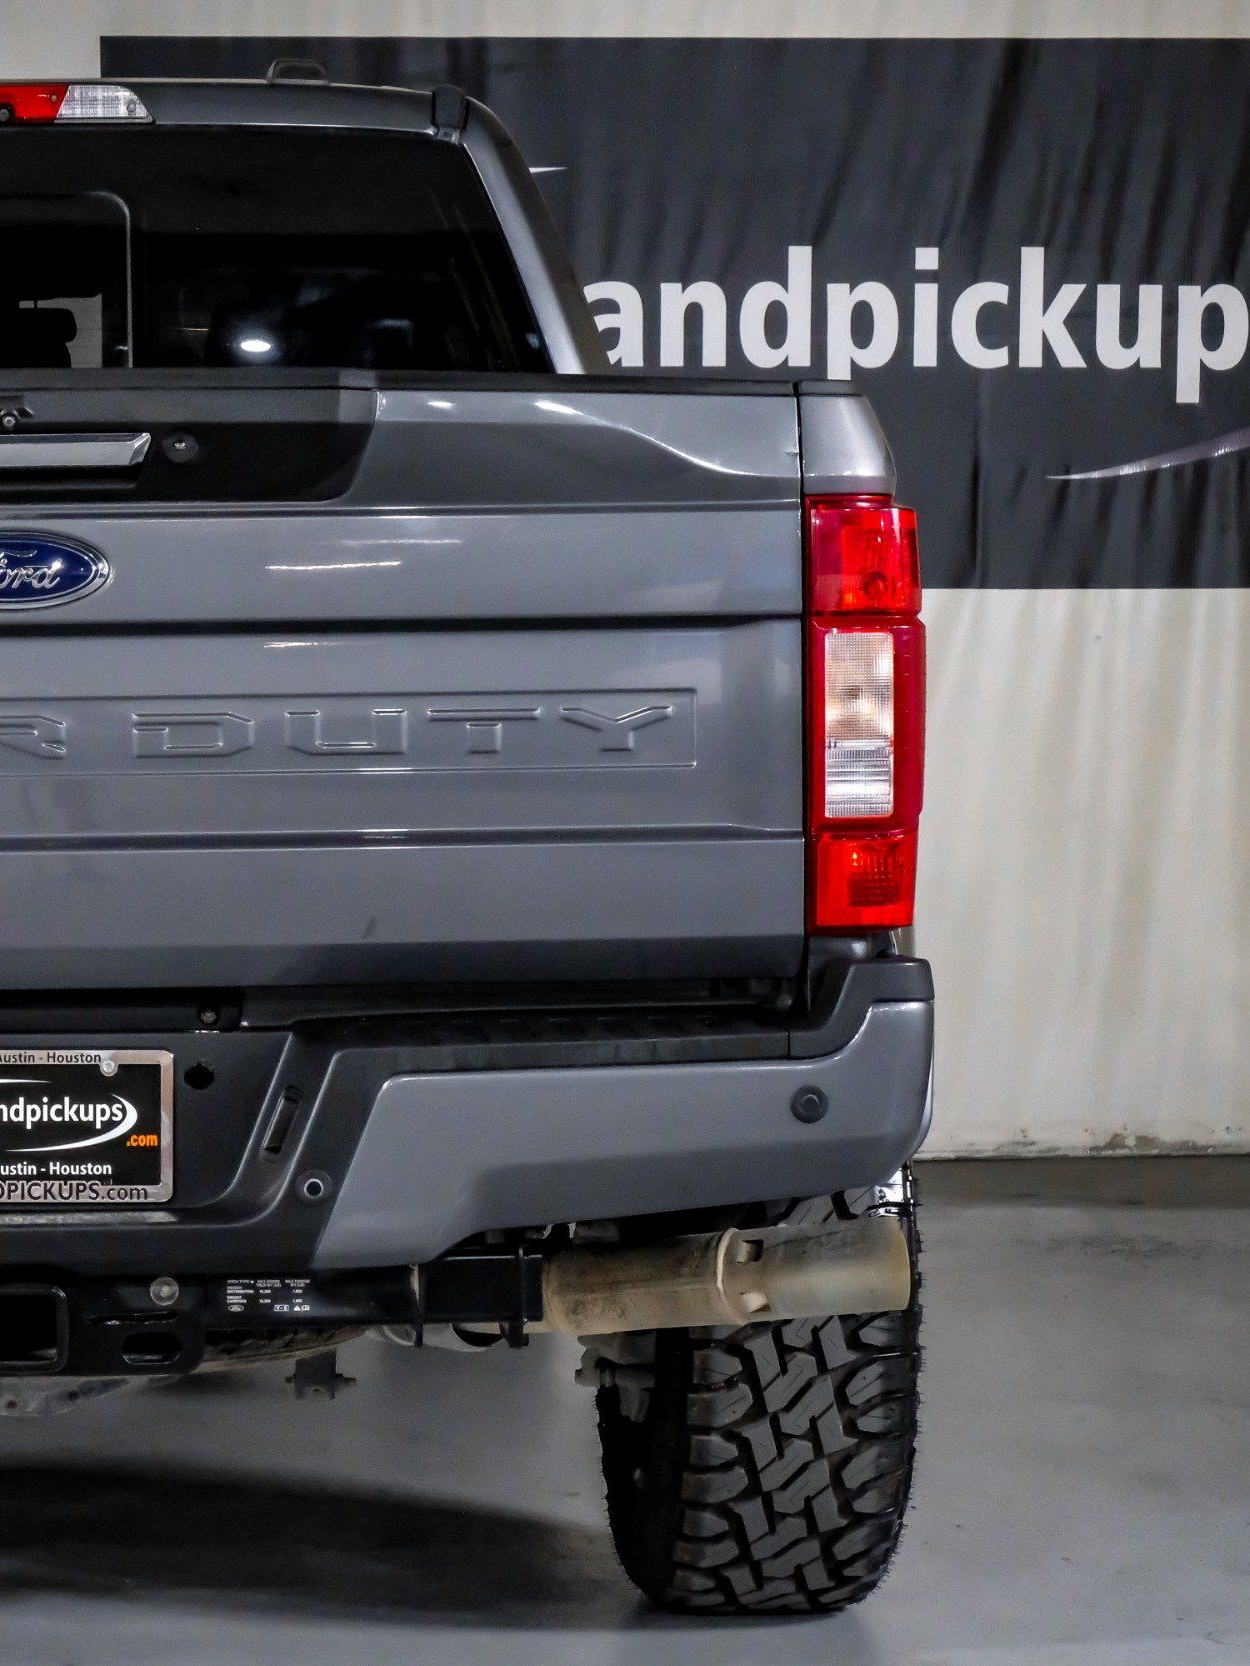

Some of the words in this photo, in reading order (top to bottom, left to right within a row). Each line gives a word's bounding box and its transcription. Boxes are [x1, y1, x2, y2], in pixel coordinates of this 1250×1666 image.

[583, 245, 1249, 404] andpickup
[132, 705, 673, 758] DUTY
[47, 1051, 101, 1063] Houston
[126, 1133, 158, 1146] .com
[49, 1162, 112, 1175] Houston
